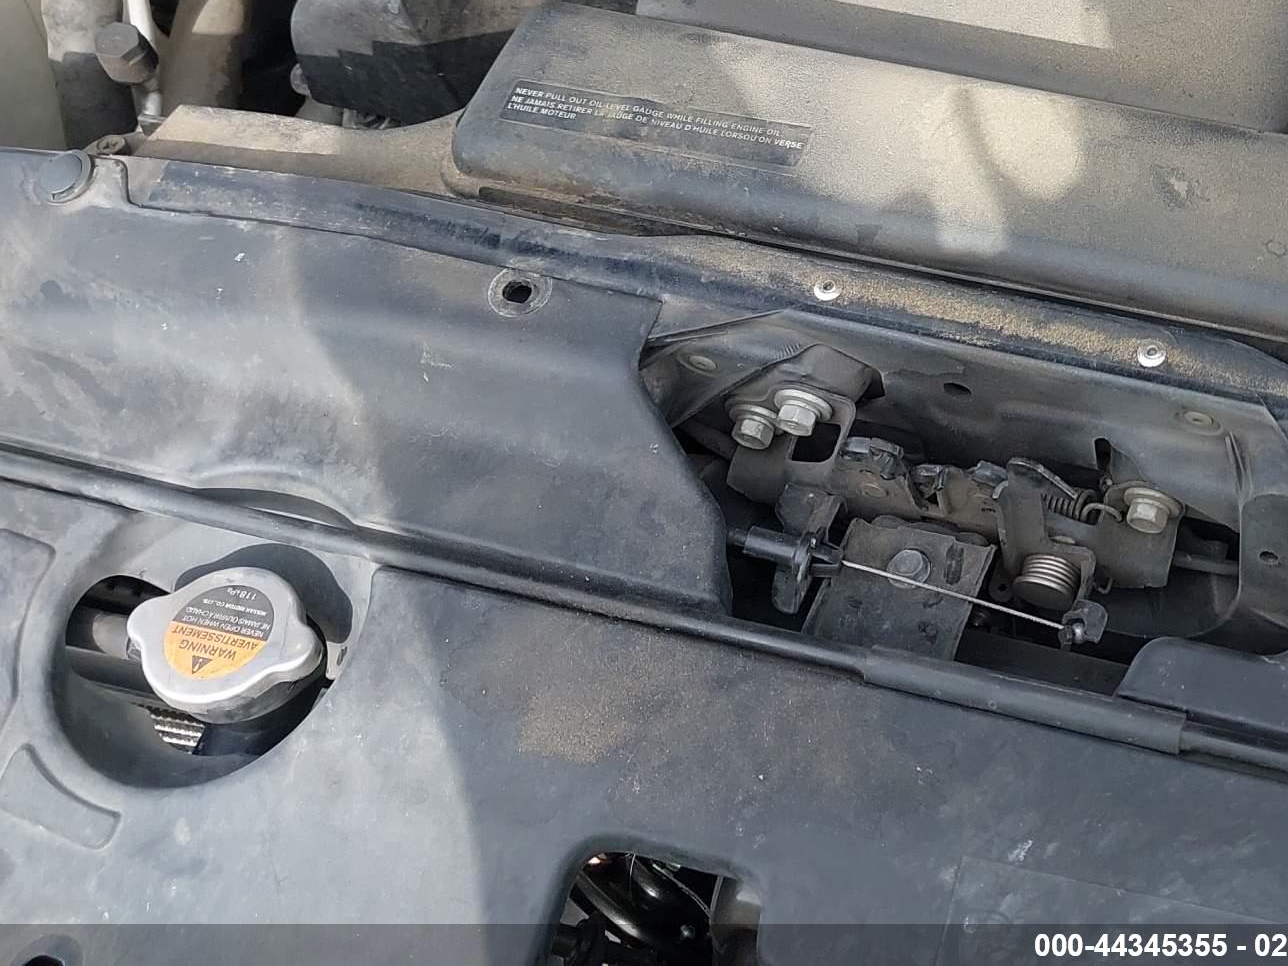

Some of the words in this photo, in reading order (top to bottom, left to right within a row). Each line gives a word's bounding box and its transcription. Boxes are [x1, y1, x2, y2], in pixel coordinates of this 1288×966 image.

[507, 103, 539, 114] L'HUILE
[515, 87, 543, 97] NEVER
[545, 92, 566, 102] PULL
[569, 96, 587, 105] OUT
[589, 99, 630, 112] OIL-LEVEL
[632, 106, 664, 118] GAUGE
[666, 113, 693, 123] WHILE
[695, 117, 729, 129] FILLING
[730, 124, 765, 134] ENGINE
[525, 97, 555, 109] JAMAIS
[557, 103, 593, 116] RETIRER
[635, 113, 650, 123] DE
[684, 124, 719, 136] D'HUILE
[774, 139, 803, 150] VERSE
[181, 615, 198, 624] HOT
[198, 618, 219, 628] WHEN
[238, 616, 261, 628] JAMAIS
[220, 622, 240, 633] OPEN
[240, 625, 264, 638] NEVER
[261, 622, 271, 630] NE
[171, 625, 259, 651] AVERTISSEMENT
[178, 639, 237, 661] WARNING
